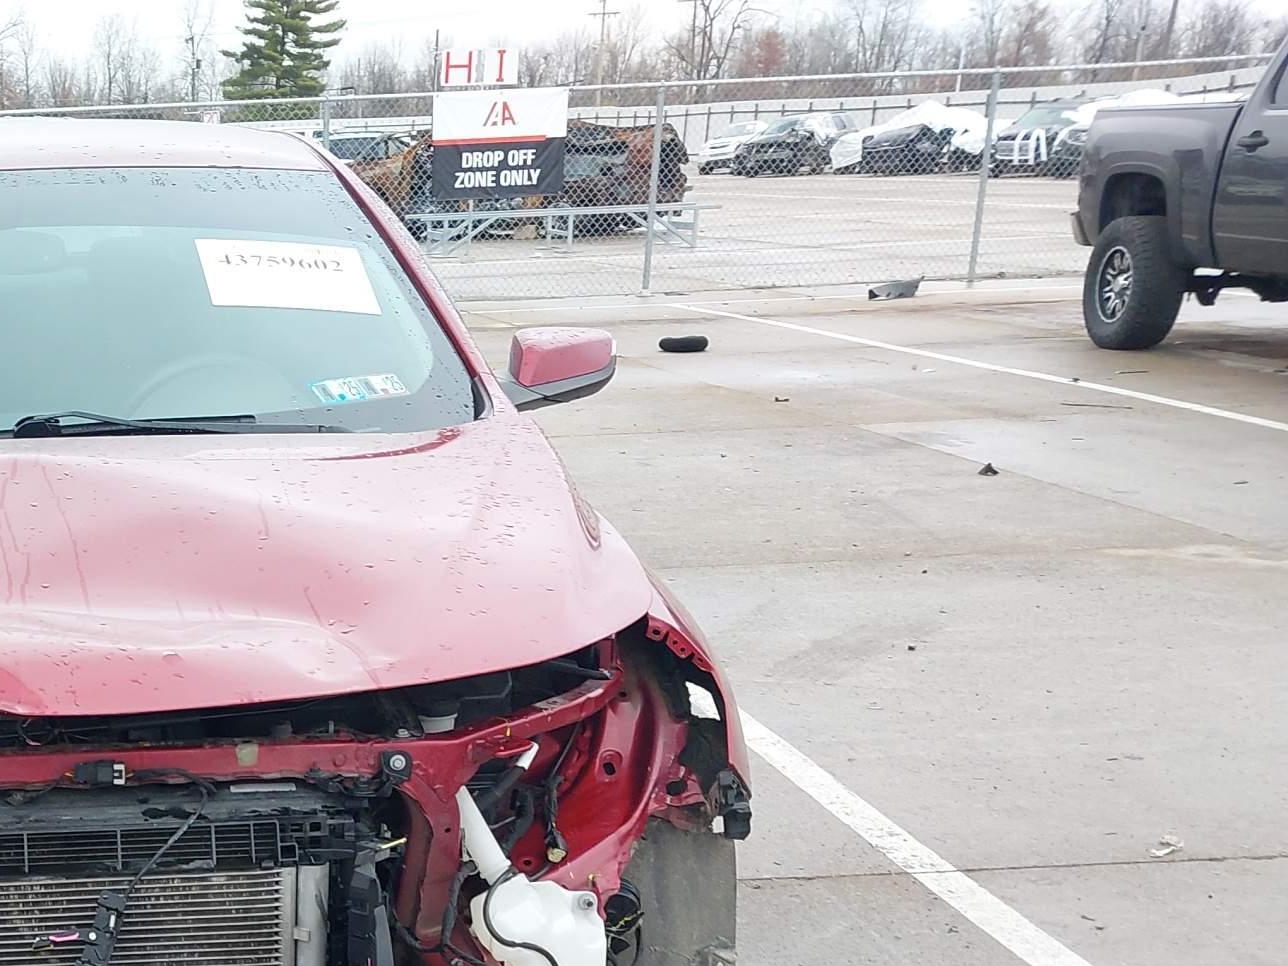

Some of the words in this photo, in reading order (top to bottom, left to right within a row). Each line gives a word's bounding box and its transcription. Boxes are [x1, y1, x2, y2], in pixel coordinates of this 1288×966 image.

[461, 150, 505, 168] DROP
[507, 148, 537, 166] OFF
[454, 170, 497, 188] ZONE
[499, 168, 542, 187] ONLY
[218, 253, 344, 272] 43759602
